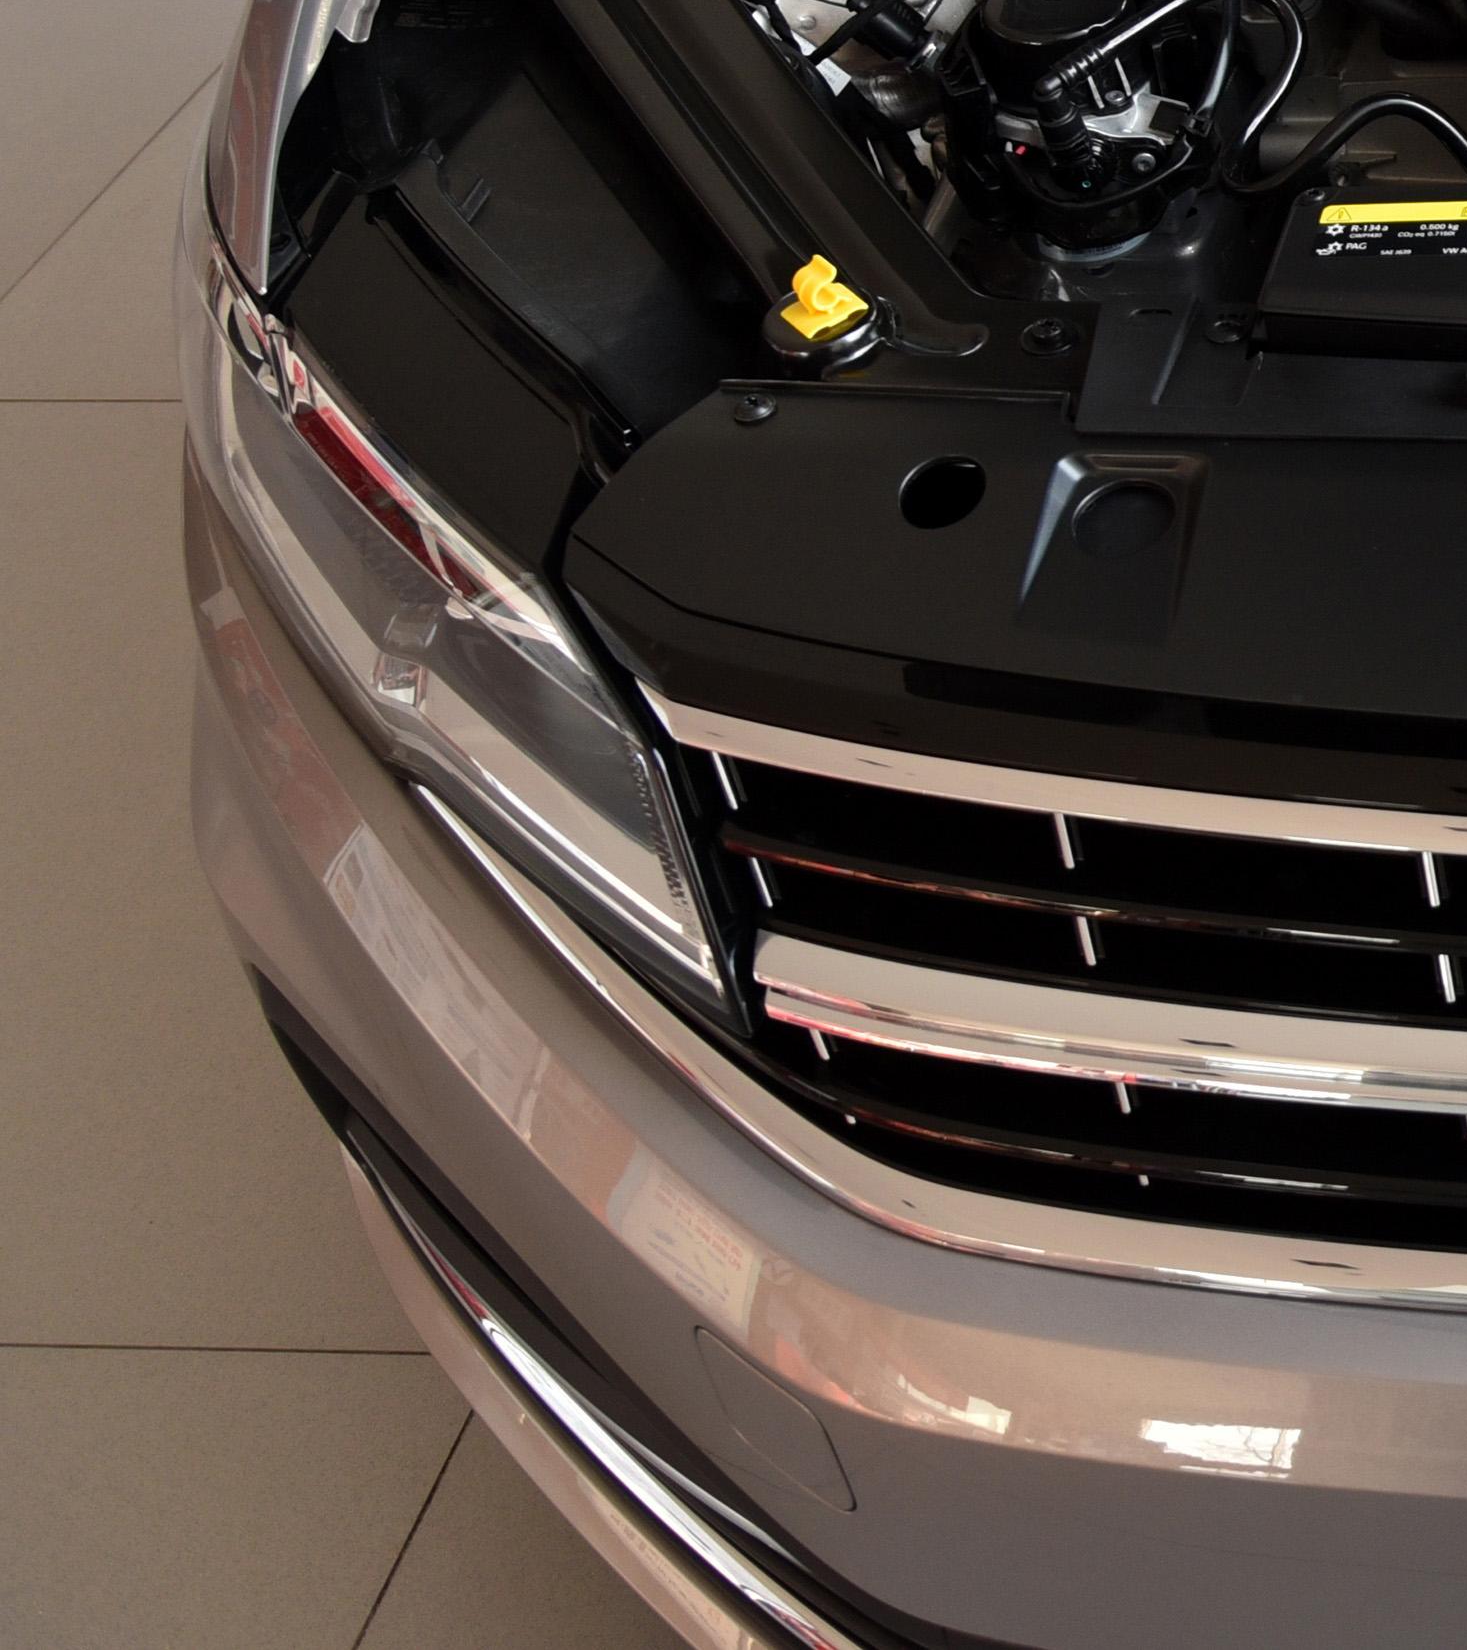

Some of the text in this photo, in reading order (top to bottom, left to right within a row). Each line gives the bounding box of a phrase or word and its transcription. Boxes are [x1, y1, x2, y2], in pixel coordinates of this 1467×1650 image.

[1447, 223, 1460, 232] kg
[1345, 242, 1367, 250] PAG
[1442, 247, 1460, 255] VW
